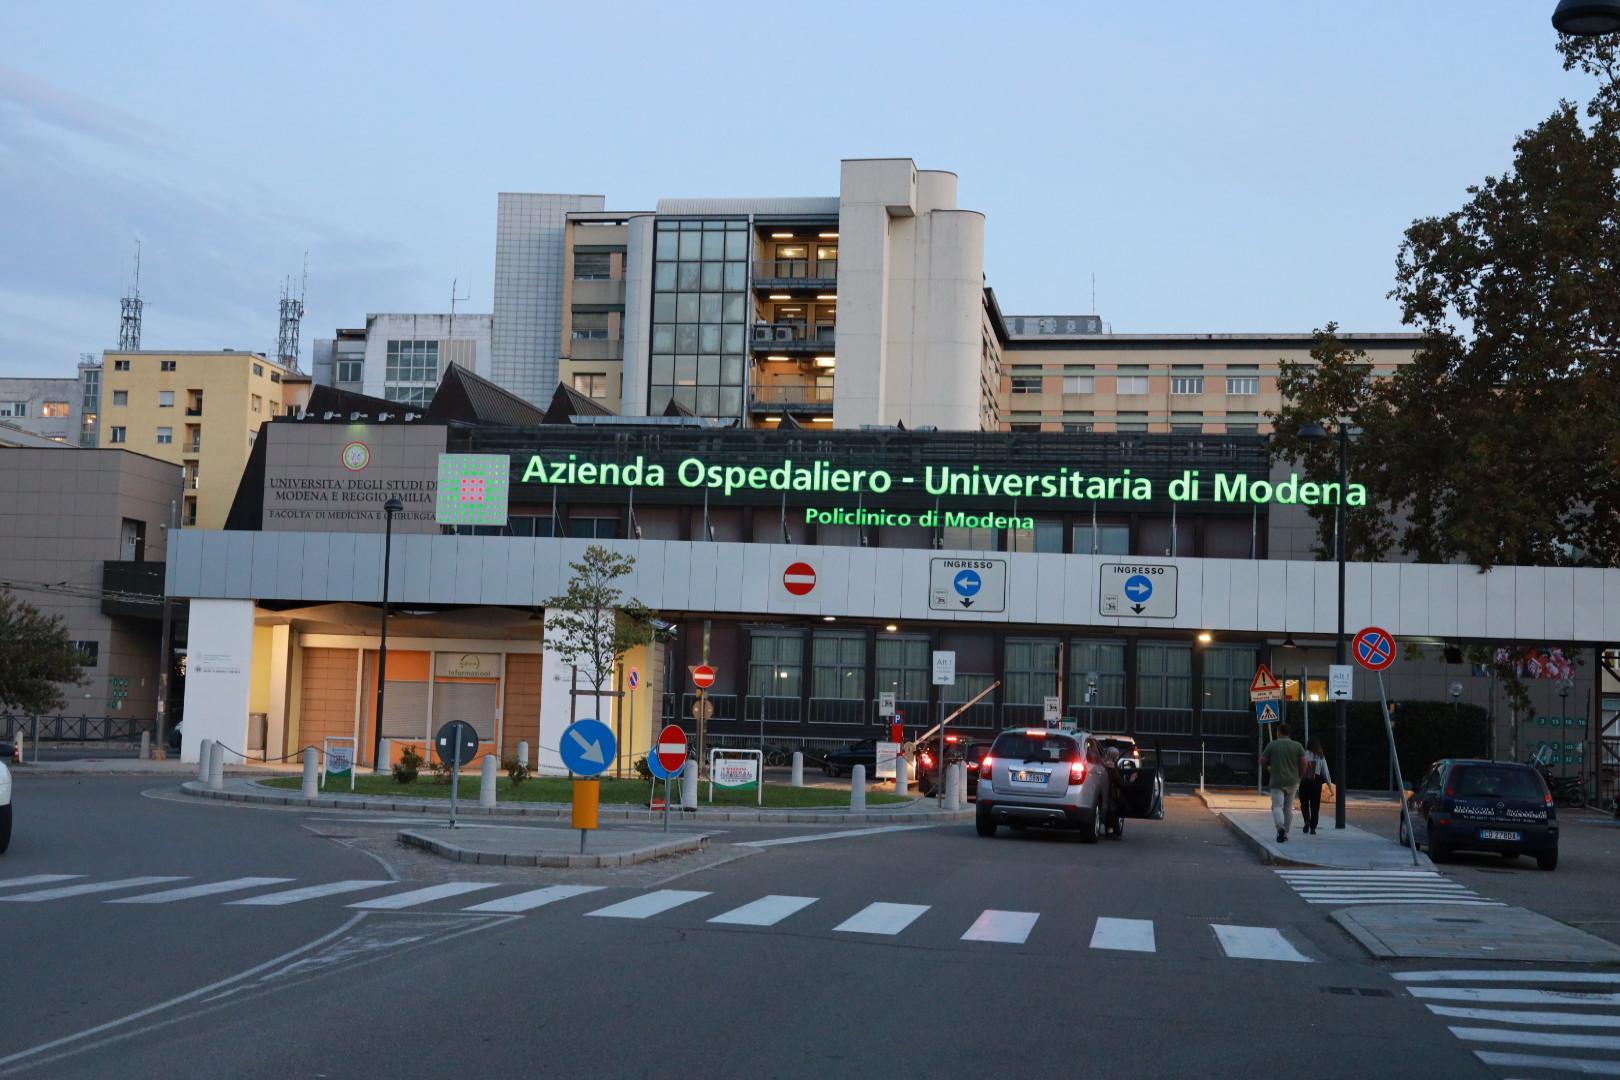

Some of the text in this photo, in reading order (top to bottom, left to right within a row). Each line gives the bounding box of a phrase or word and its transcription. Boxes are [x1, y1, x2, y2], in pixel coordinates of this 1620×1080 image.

[269, 478, 346, 489] UNIVERSITA'
[348, 480, 383, 490] DEGLI
[386, 480, 424, 491] STUDI
[521, 454, 1367, 506] Azienda Ospedaliero - Universitaria di Modena
[275, 490, 432, 503] MODENA E REGGIO EMILIA
[269, 510, 314, 519] FACOLTA'
[315, 511, 325, 519] DI
[327, 511, 373, 520] MEDICINA
[376, 512, 381, 520] E
[805, 507, 1035, 532] Policlinico di Modena
[943, 560, 993, 569] INGRESSO
[1113, 566, 1164, 575] INGRESSO
[895, 714, 901, 723] P
